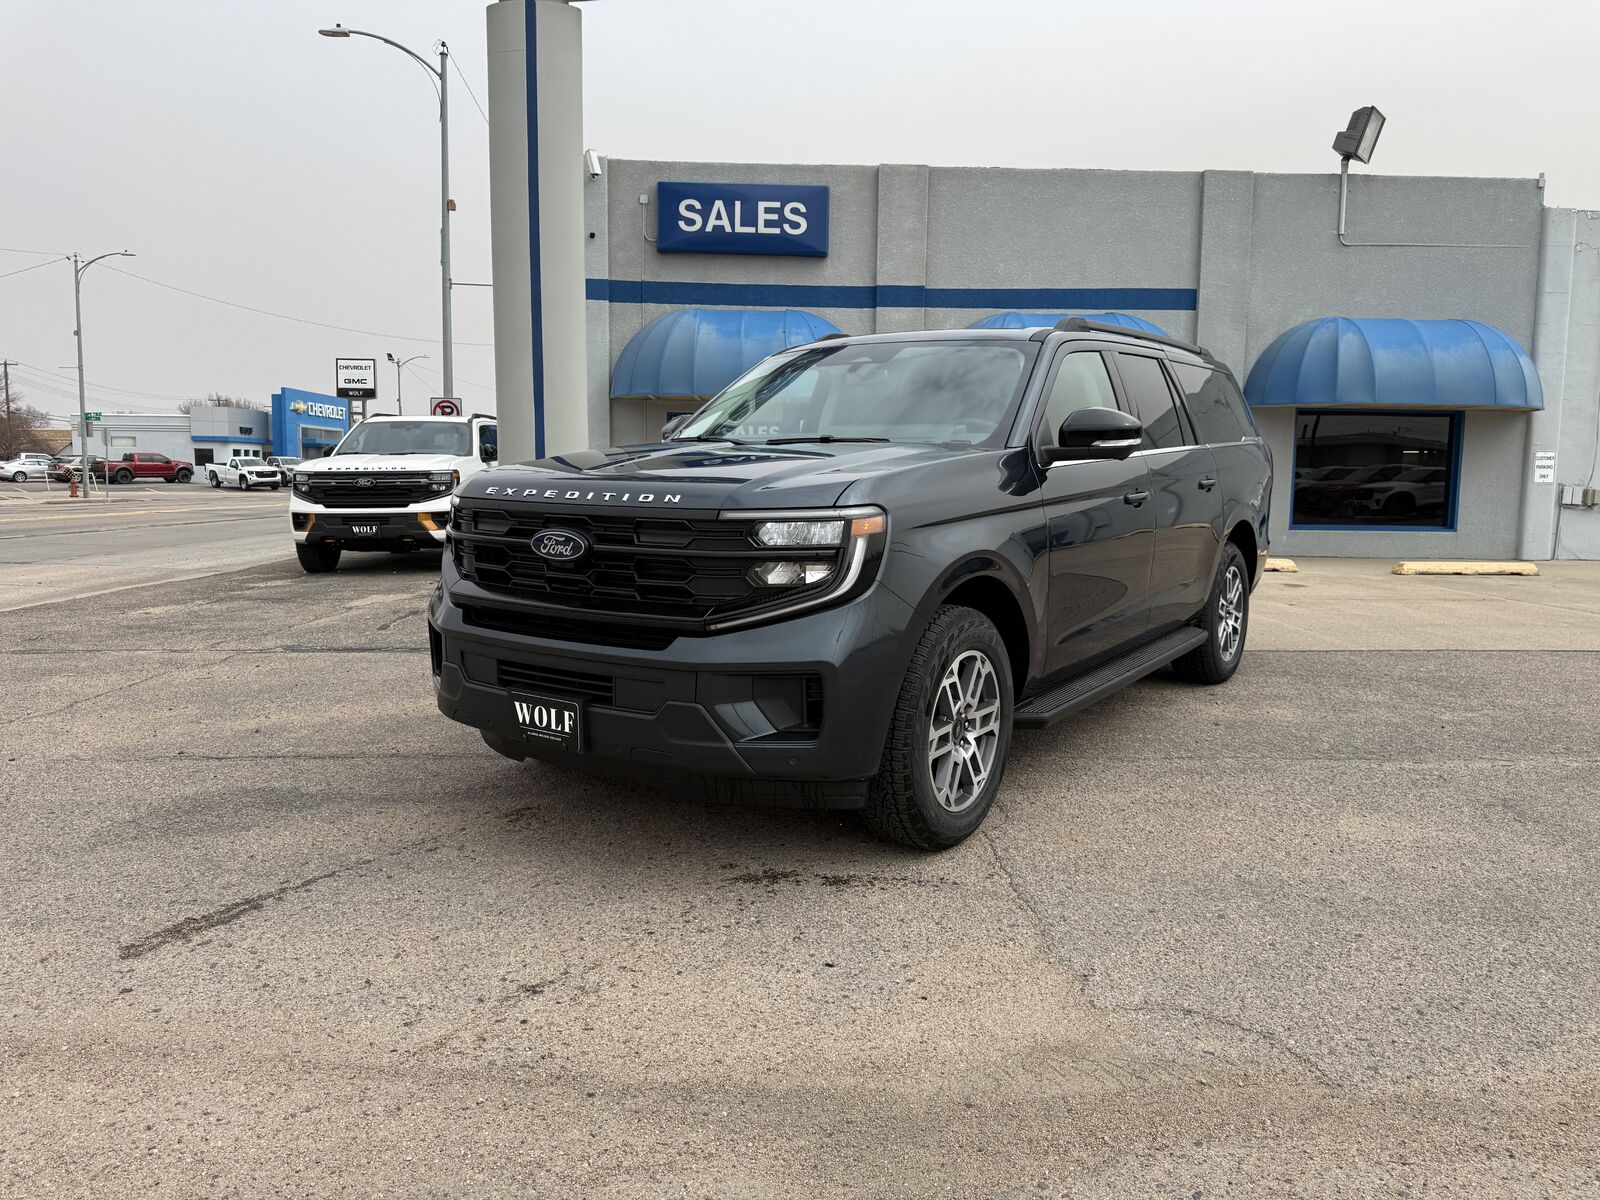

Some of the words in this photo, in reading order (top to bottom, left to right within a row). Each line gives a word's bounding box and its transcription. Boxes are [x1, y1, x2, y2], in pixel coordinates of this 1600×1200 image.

[677, 198, 808, 236] SALES
[307, 402, 347, 420] CHEVROLET
[485, 486, 682, 504] EXPEDITION
[351, 525, 378, 534] WOLF
[540, 534, 574, 556] Ford
[513, 700, 575, 734] WOLF
